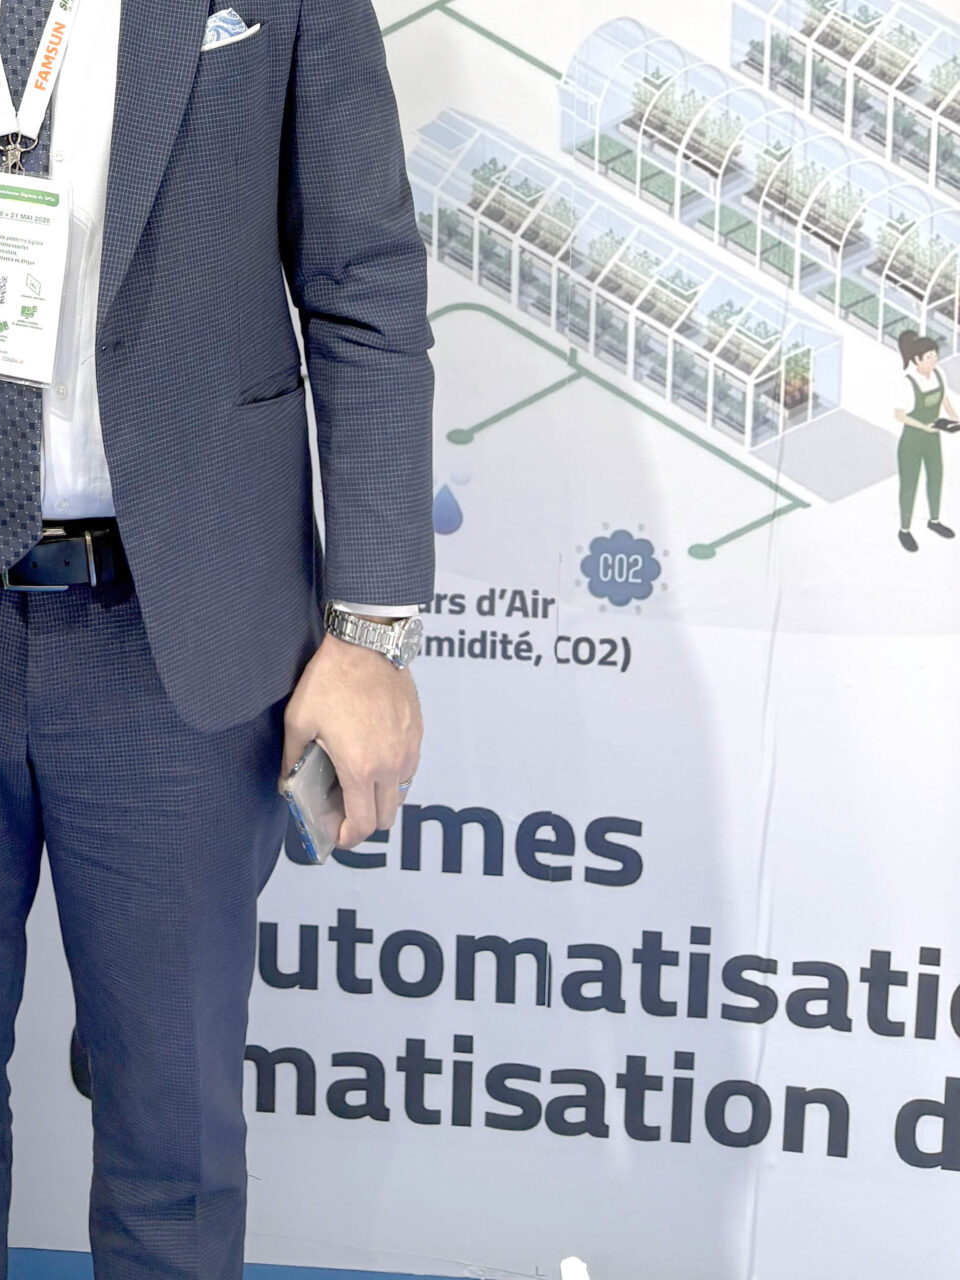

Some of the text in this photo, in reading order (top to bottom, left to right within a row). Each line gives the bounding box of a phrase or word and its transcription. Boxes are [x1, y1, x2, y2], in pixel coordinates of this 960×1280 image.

[34, 21, 67, 91] FAMSUN
[599, 553, 643, 583] CO2
[418, 630, 631, 673] midité, CO2)
[258, 907, 960, 1041] utomatisati
